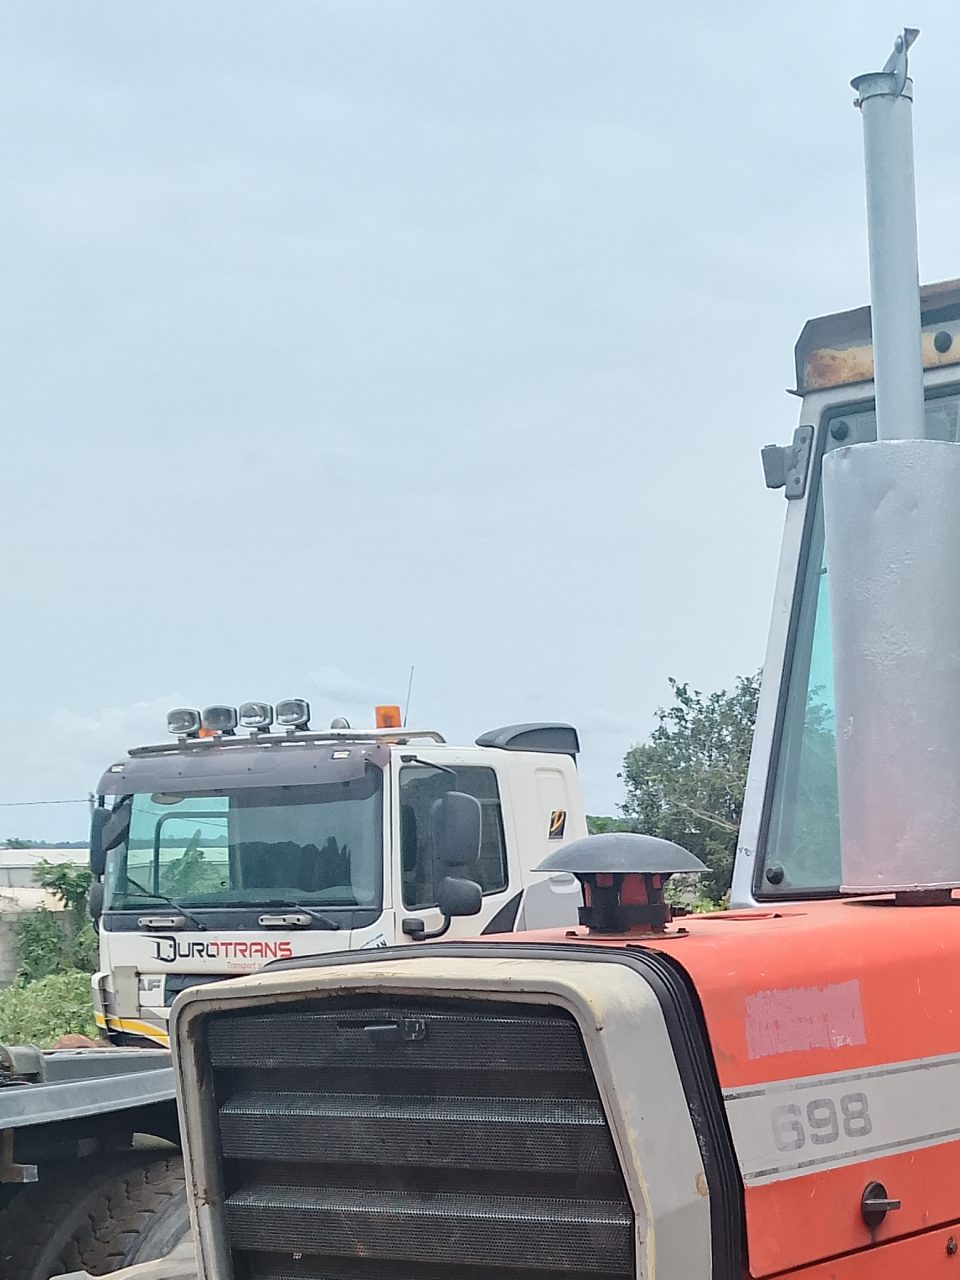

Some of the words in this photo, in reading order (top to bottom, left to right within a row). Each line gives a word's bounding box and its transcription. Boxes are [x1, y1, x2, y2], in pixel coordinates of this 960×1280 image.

[151, 936, 293, 962] DUROTRANS
[227, 961, 256, 970] Transport
[771, 1092, 872, 1152] 698
